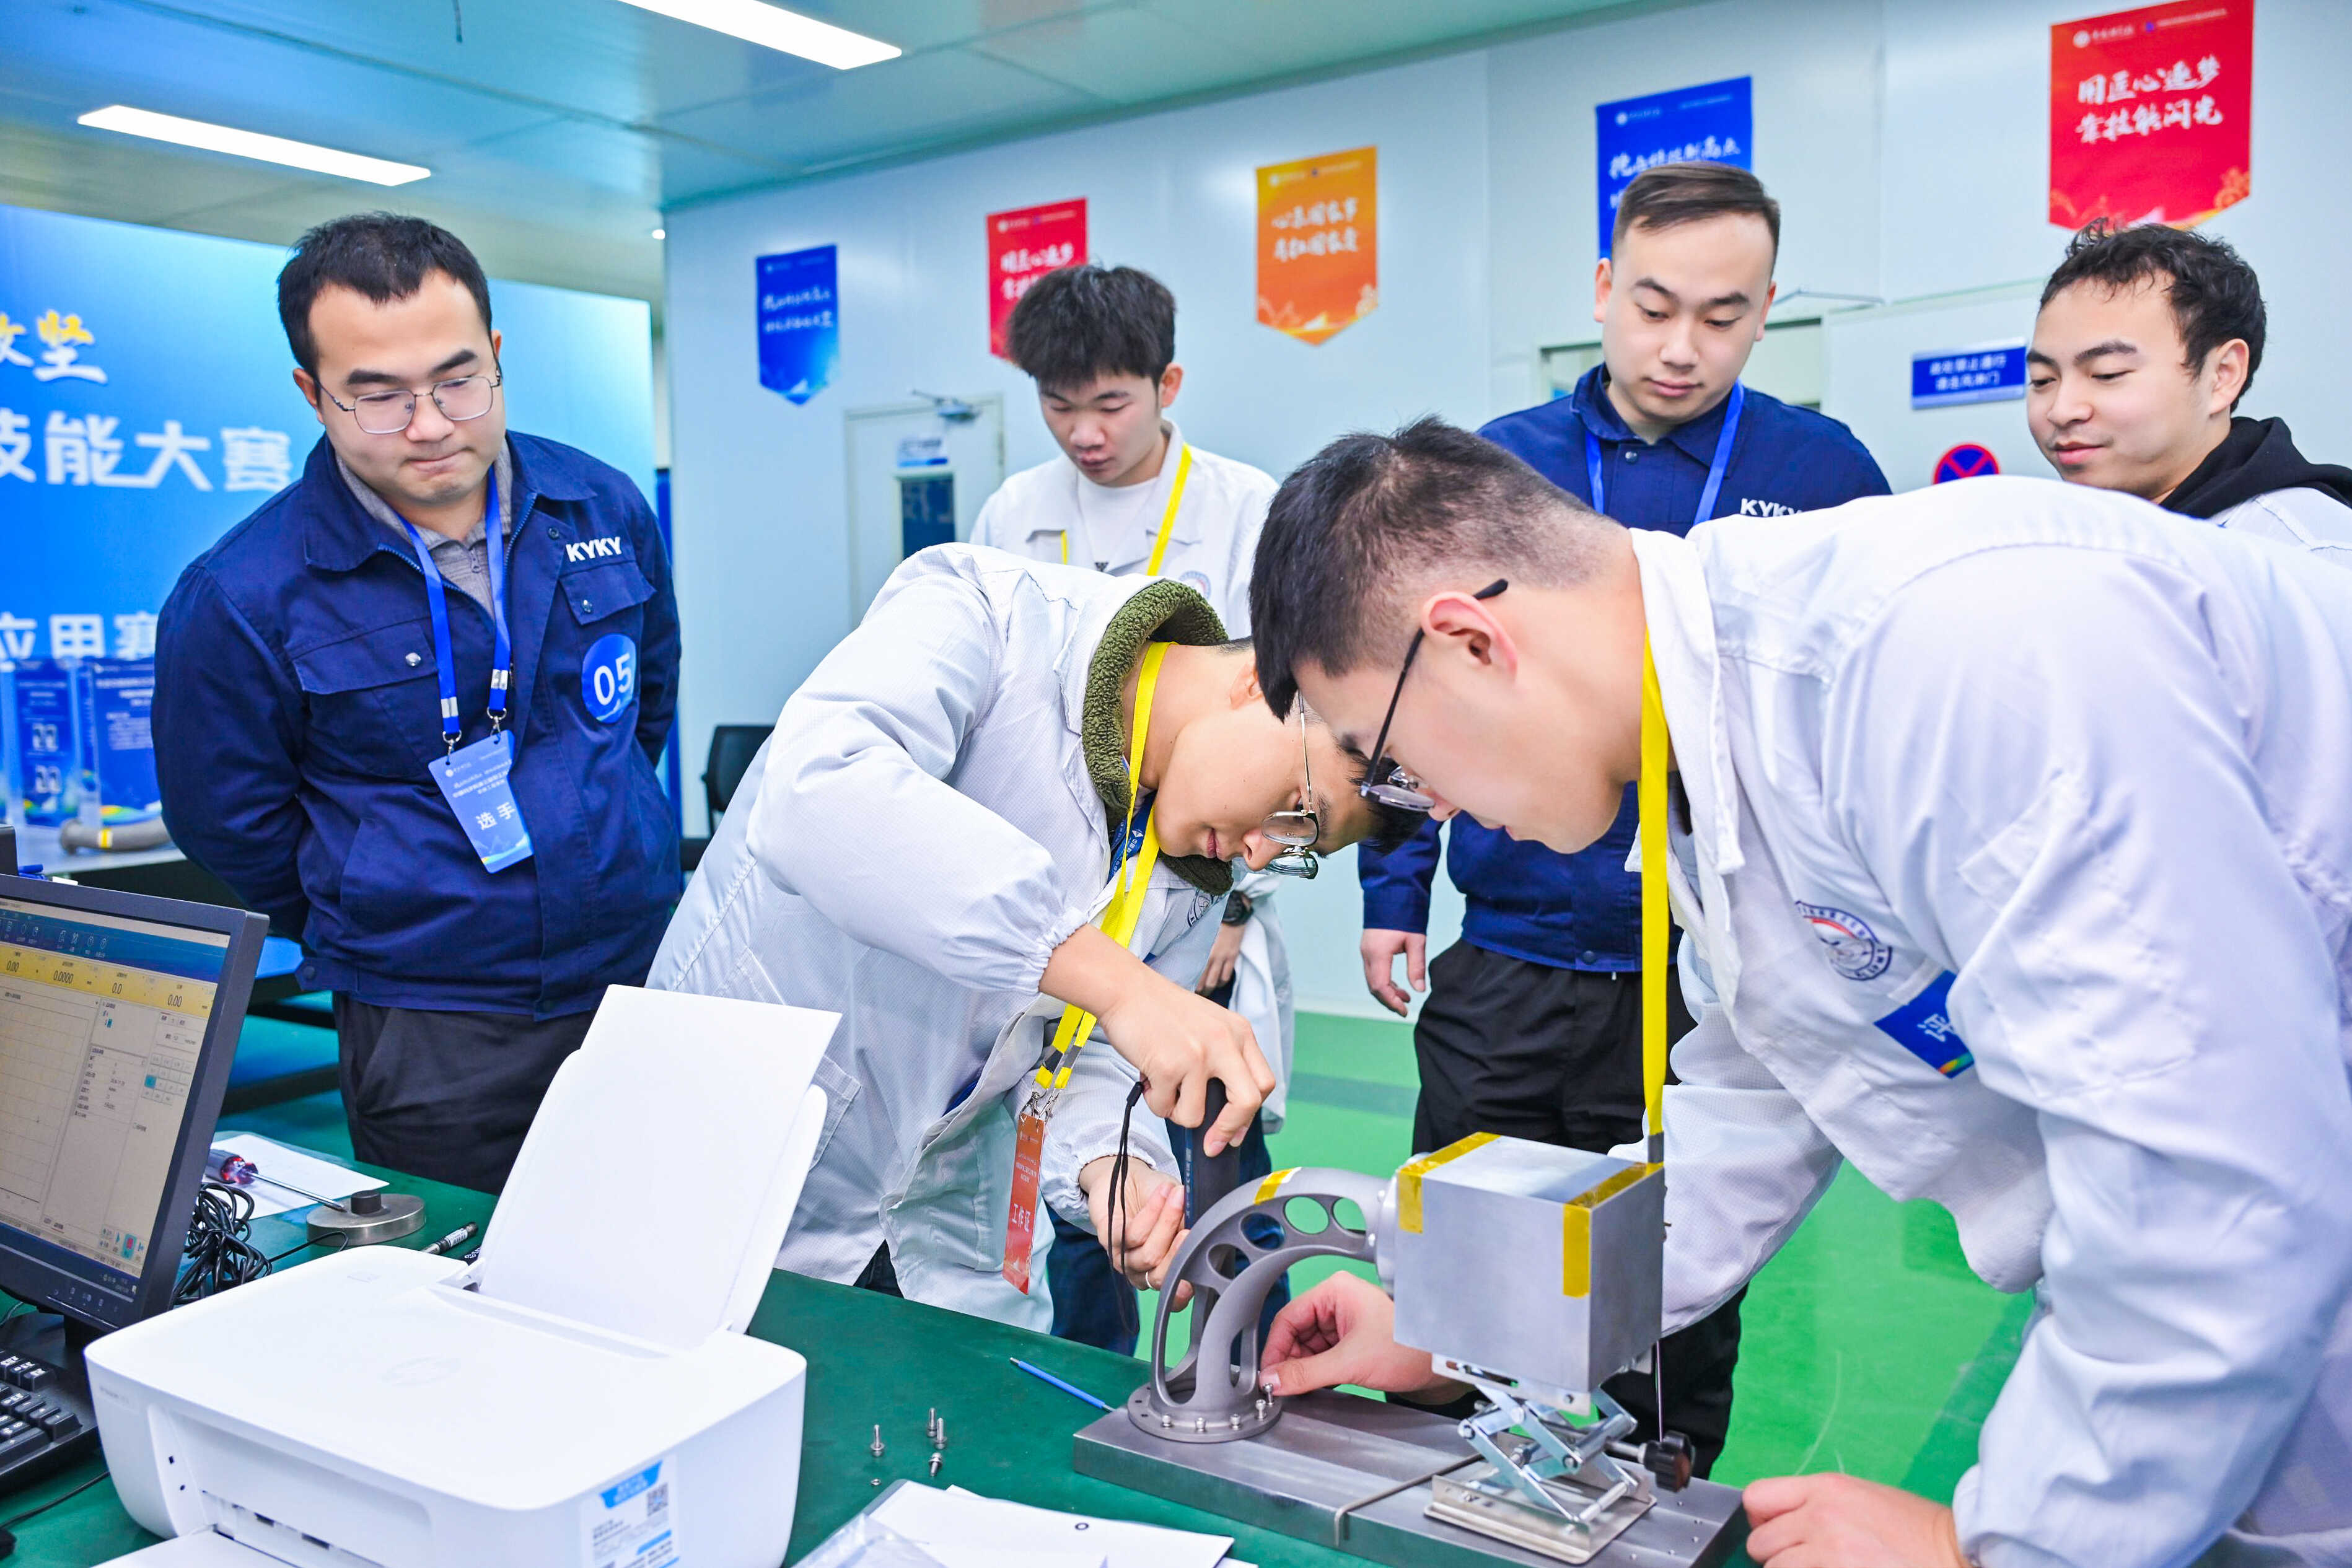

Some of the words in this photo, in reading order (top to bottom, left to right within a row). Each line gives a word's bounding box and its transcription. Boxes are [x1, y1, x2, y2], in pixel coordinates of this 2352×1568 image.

[2078, 54, 2220, 105] 用匠心追梦
[2076, 94, 2223, 144] 靠技能闪光
[566, 537, 622, 563] KYKY
[594, 652, 632, 706] 05
[475, 801, 517, 831] 选手
[6, 960, 20, 973] 0.00
[53, 970, 74, 985] 0.0000
[112, 982, 123, 995] 0.0
[167, 994, 183, 1009] 0.00
